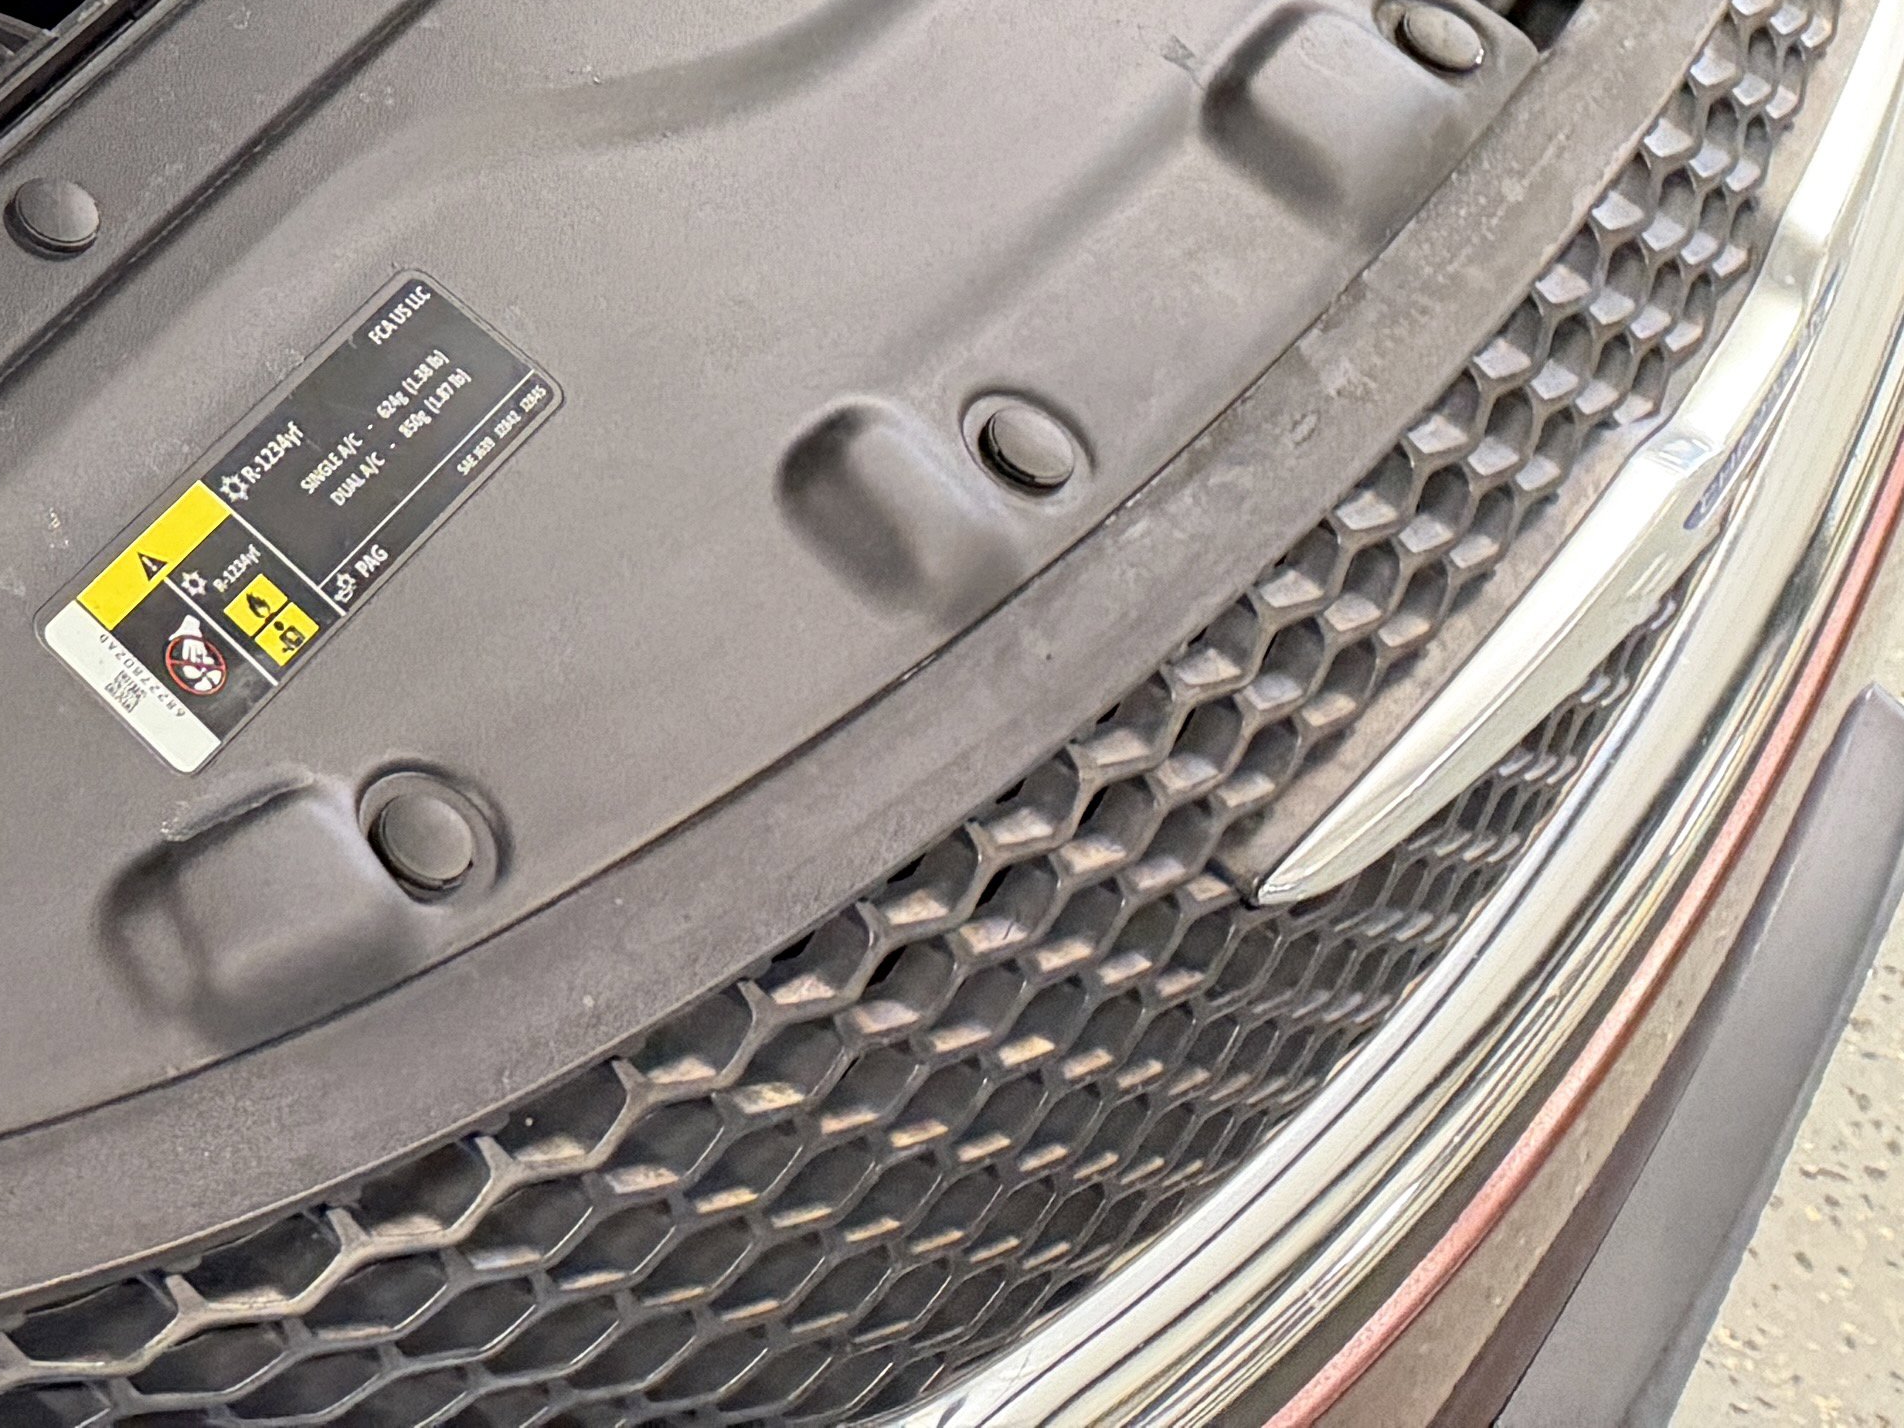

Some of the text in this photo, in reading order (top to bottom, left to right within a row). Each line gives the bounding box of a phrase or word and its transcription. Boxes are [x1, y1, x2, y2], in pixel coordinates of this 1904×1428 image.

[367, 285, 432, 345] FCA US LLC
[240, 421, 304, 484] R-1234yf
[300, 452, 343, 494] SINGLE
[336, 432, 363, 459] A/C
[330, 473, 366, 506] DUAL
[359, 451, 385, 479] A/C
[354, 544, 389, 578] PAG
